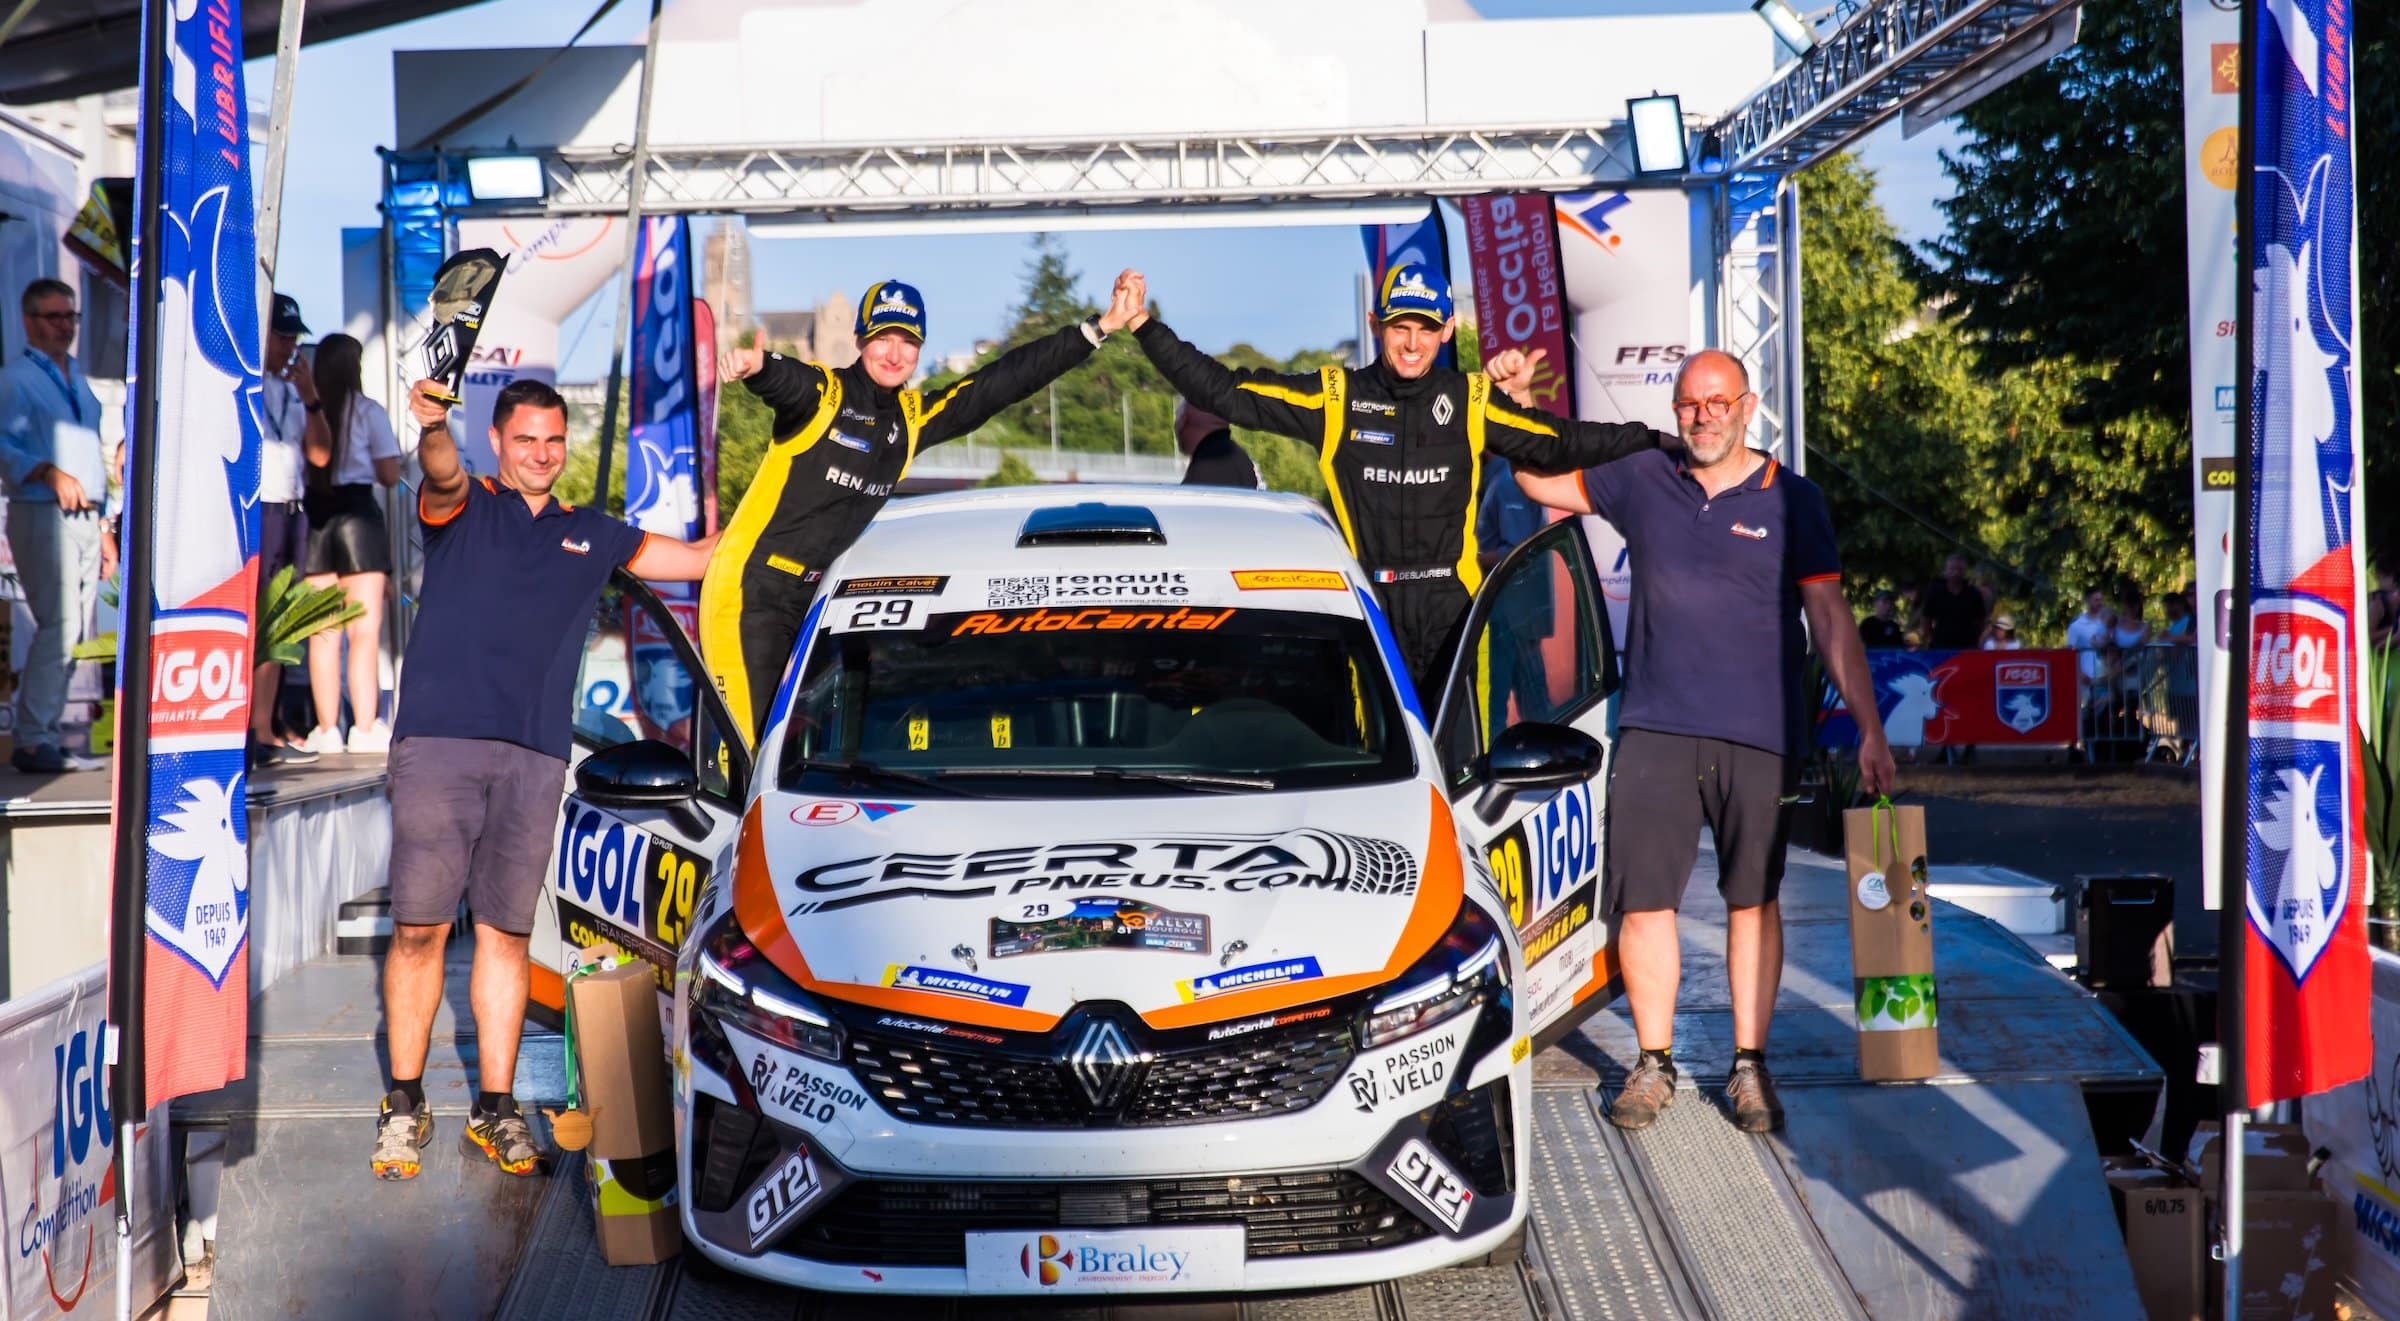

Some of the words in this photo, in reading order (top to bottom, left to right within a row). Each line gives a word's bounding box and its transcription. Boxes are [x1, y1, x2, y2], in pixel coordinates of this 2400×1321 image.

[826, 466, 893, 497] RENAULT
[1363, 467, 1450, 484] RENAULT
[848, 580, 892, 590] moulin
[897, 579, 938, 587] Calvet
[1056, 573, 1186, 584] renault
[849, 600, 914, 629] 29
[952, 608, 1236, 637] AutoCantal
[2256, 632, 2333, 688] IGOL
[151, 650, 246, 703] IGOL
[1534, 782, 1597, 912] IGOL
[558, 801, 645, 928] IGOL
[795, 843, 1310, 893] CEERTA
[657, 851, 696, 945] 29
[1008, 872, 1351, 895] PNEUS.COM
[1489, 837, 1524, 928] 29
[196, 902, 230, 925] DEPUIS
[1023, 903, 1049, 918] 29
[2282, 899, 2314, 921] DEPUIS
[203, 927, 226, 948] 1949
[594, 918, 668, 967] TRANSPORTS
[2288, 923, 2311, 945] 1949
[922, 974, 1013, 999] MICHELIN
[1219, 963, 1305, 988] MICHELIN
[1386, 1034, 1455, 1074] PASSION
[786, 1066, 867, 1112] PASSION
[1392, 1060, 1443, 1098] VÉLO
[779, 1086, 836, 1124] VÉLO
[21, 1180, 96, 1258] Compétition
[2145, 1199, 2185, 1214] 6/0,75
[1078, 1244, 1190, 1280] Braley
